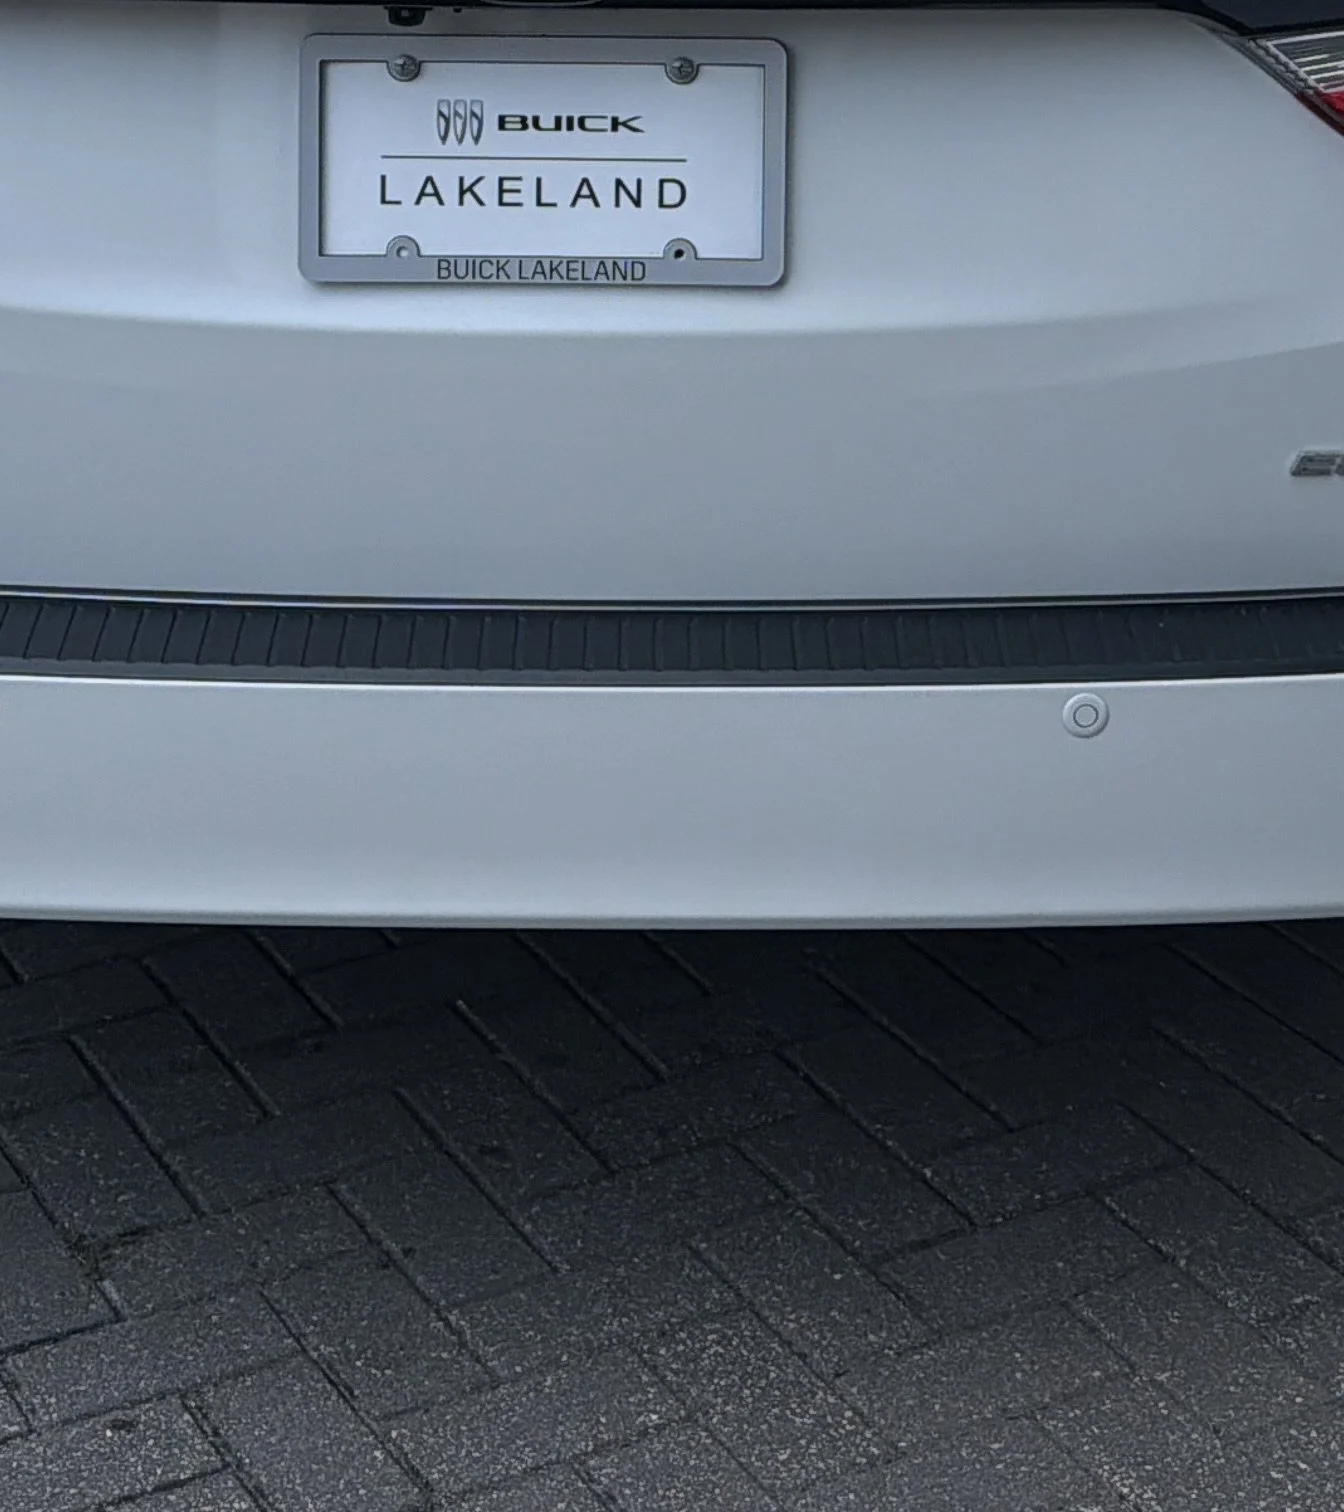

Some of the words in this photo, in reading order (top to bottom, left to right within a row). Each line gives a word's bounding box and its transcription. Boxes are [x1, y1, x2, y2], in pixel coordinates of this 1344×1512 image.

[496, 114, 646, 134] BUICK
[379, 173, 688, 210] LAKELAND
[436, 258, 512, 281] BUICK
[517, 259, 647, 283] LAKELAND
